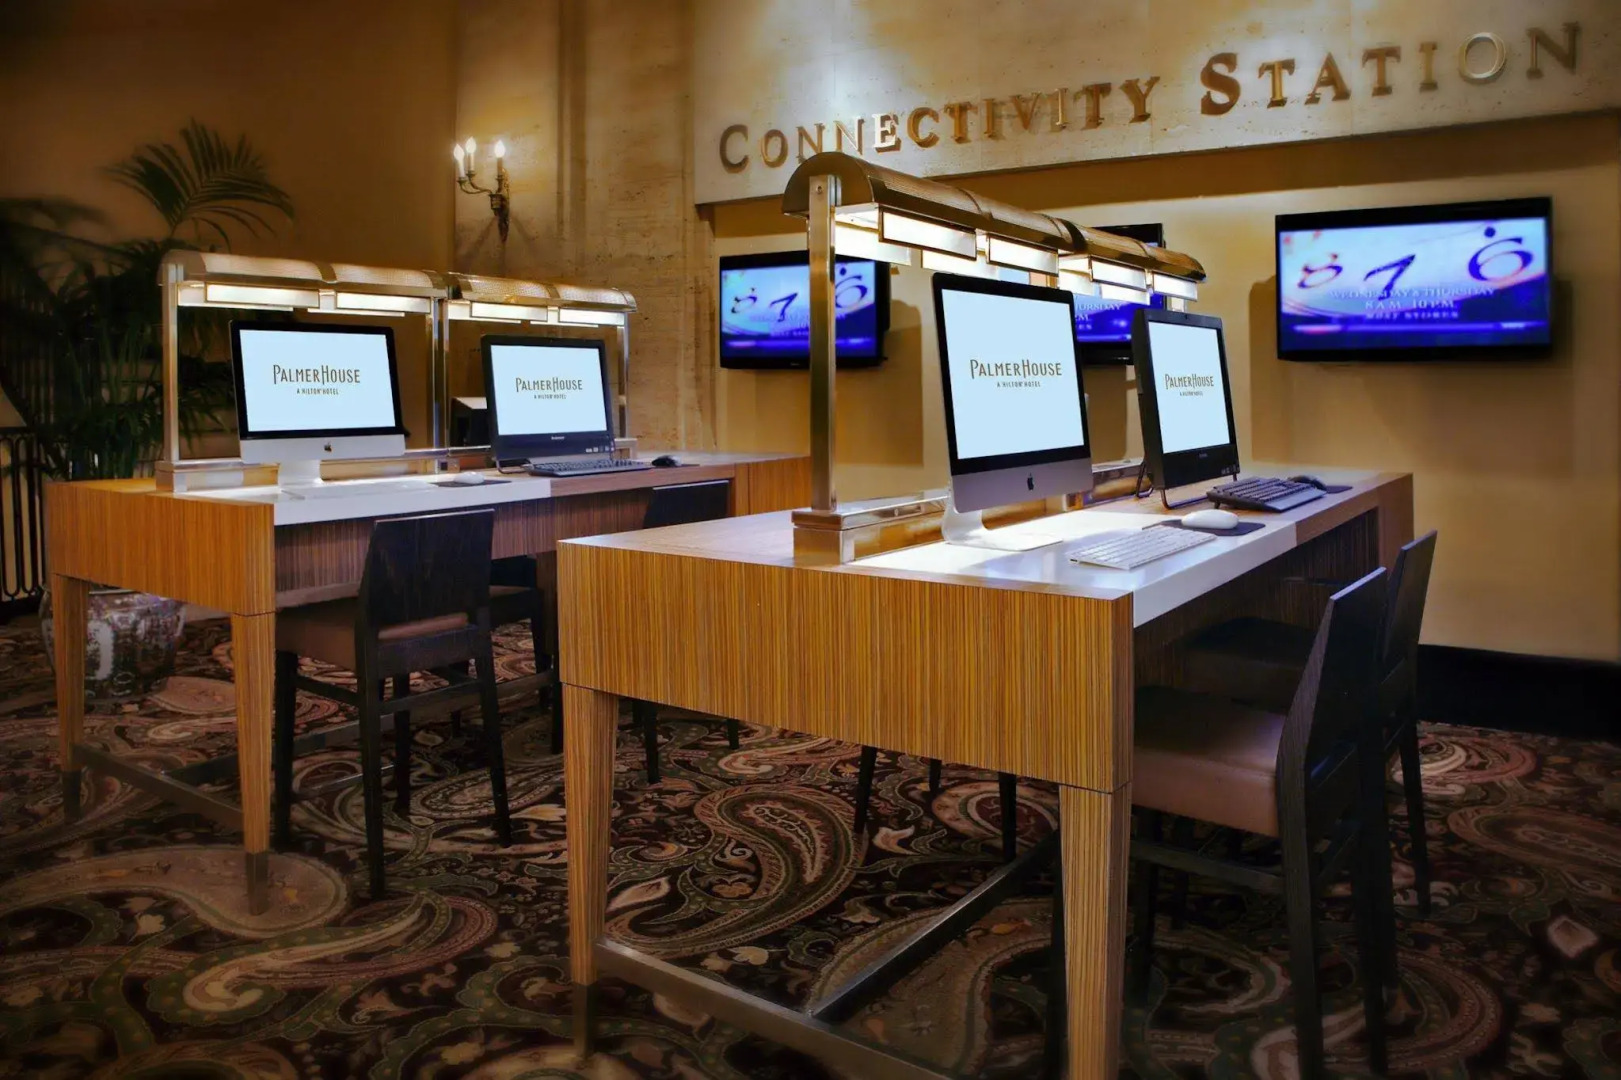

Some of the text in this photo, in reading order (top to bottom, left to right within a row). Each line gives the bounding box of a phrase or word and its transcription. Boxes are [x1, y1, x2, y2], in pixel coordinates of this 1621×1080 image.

[719, 21, 1582, 173] CONNECTIVITY STATION
[322, 387, 339, 395] HOTEL
